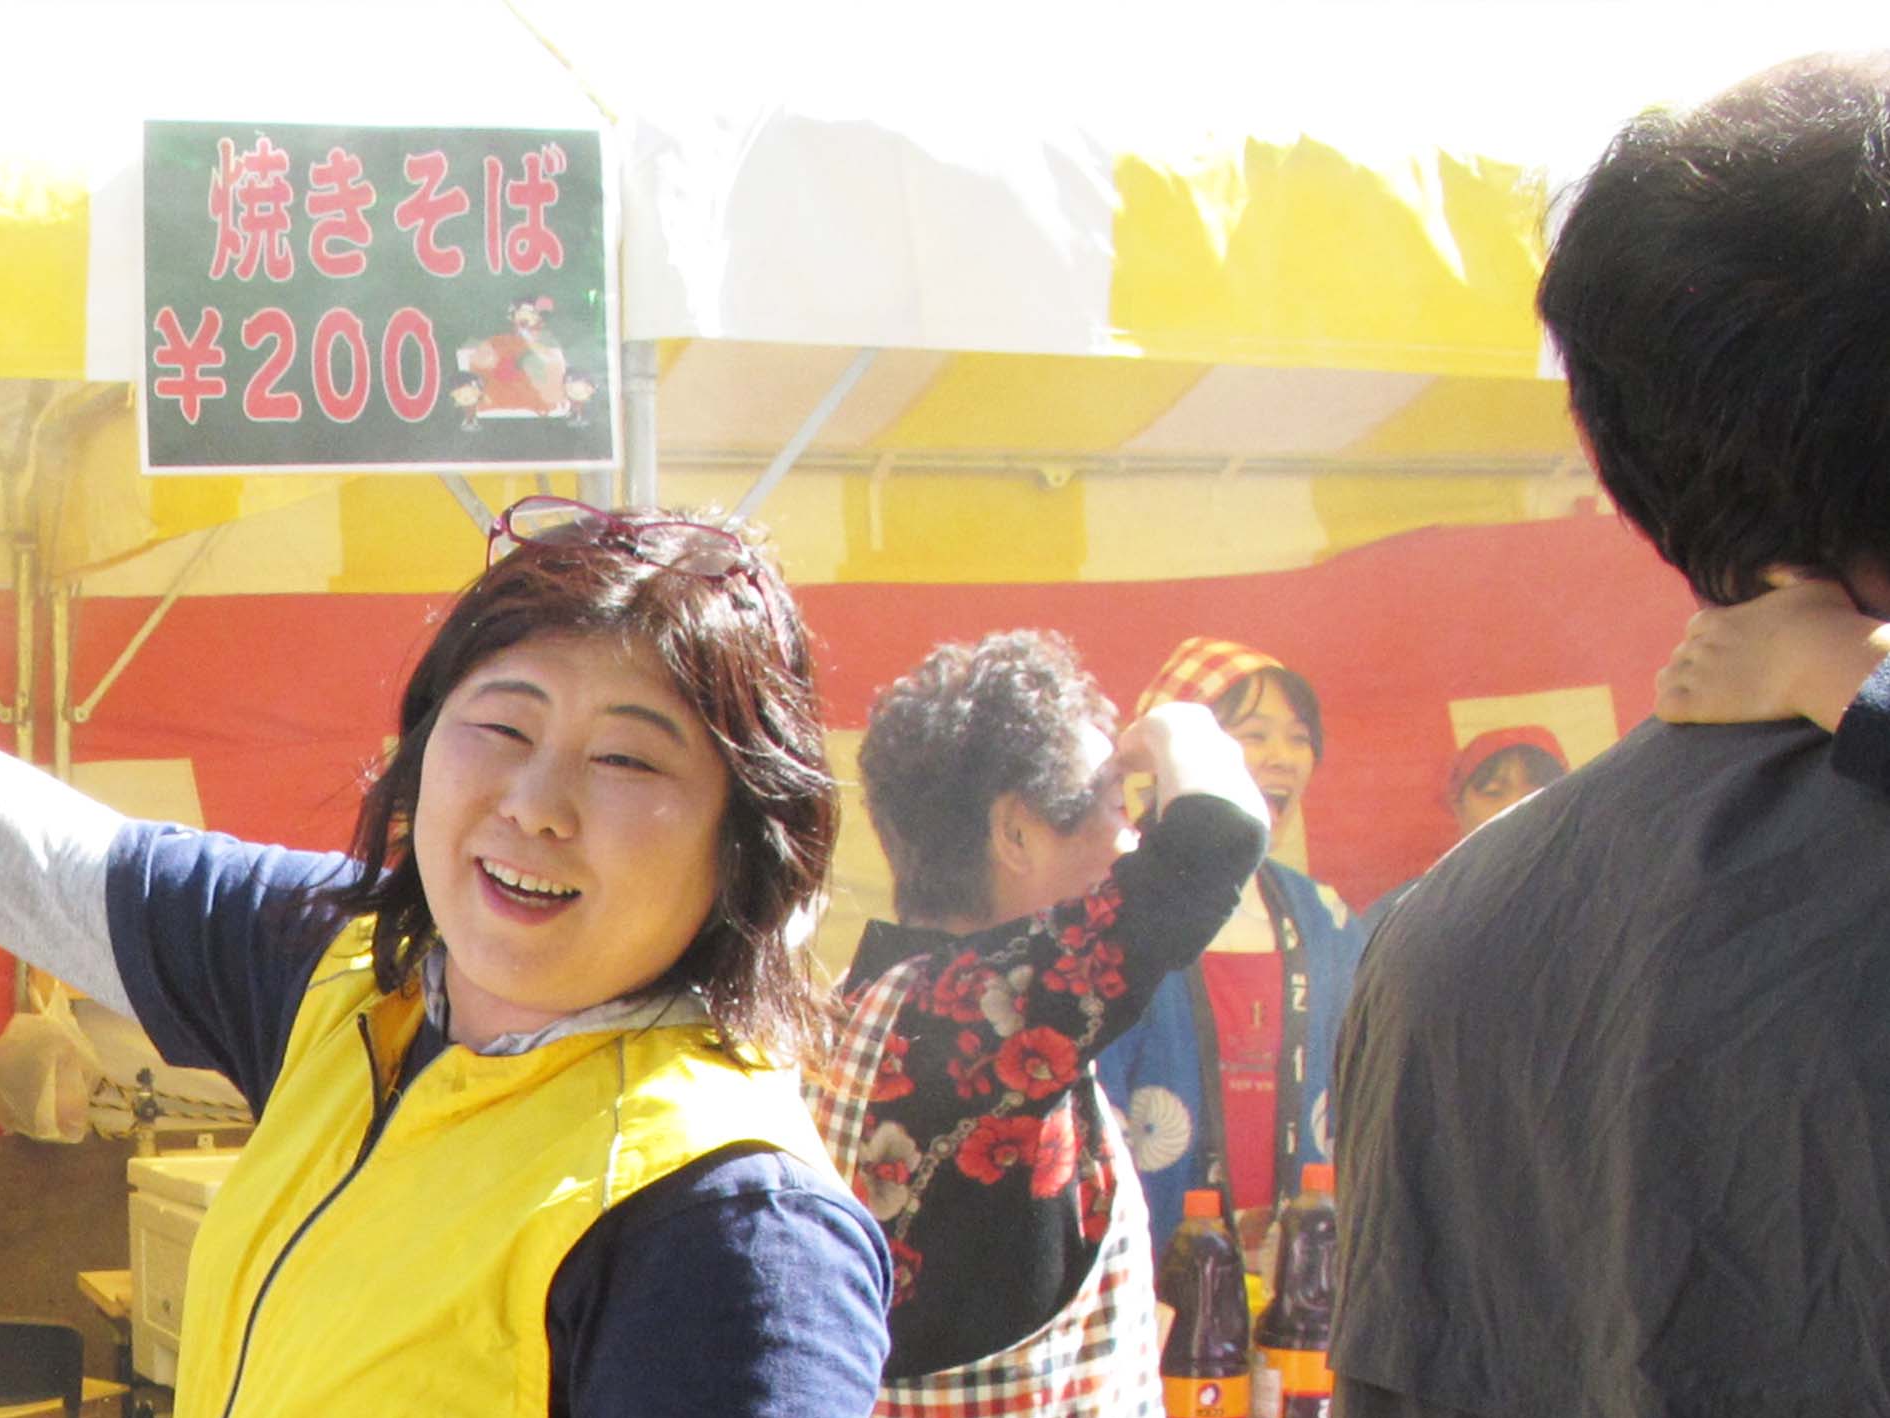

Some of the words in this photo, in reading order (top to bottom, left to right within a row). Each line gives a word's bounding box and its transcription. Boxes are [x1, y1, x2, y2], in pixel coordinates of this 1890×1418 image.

[208, 136, 567, 282] 焼きそば
[153, 305, 441, 425] ¥200
